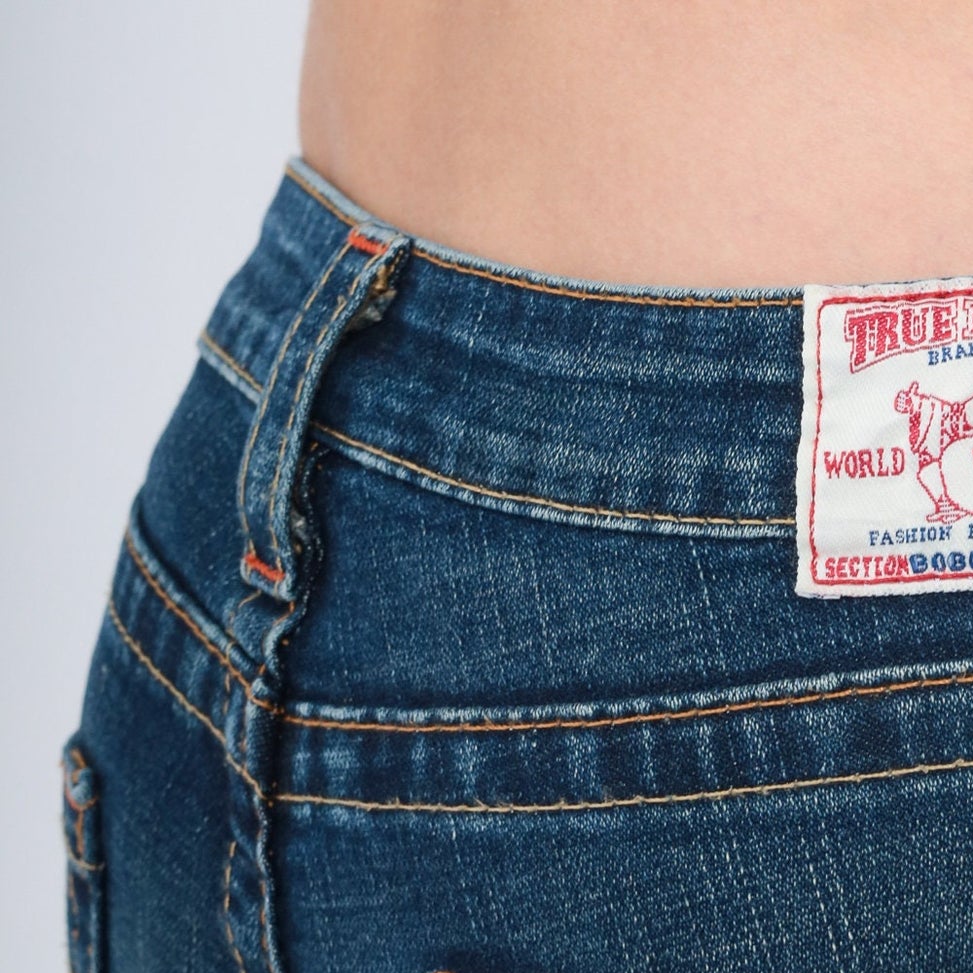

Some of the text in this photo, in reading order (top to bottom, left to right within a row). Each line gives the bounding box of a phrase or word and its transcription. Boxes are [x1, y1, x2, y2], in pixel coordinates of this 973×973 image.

[847, 303, 955, 368] TRUE
[824, 447, 905, 479] WORLD
[869, 525, 953, 546] FASHION
[825, 555, 911, 578] SECTION
